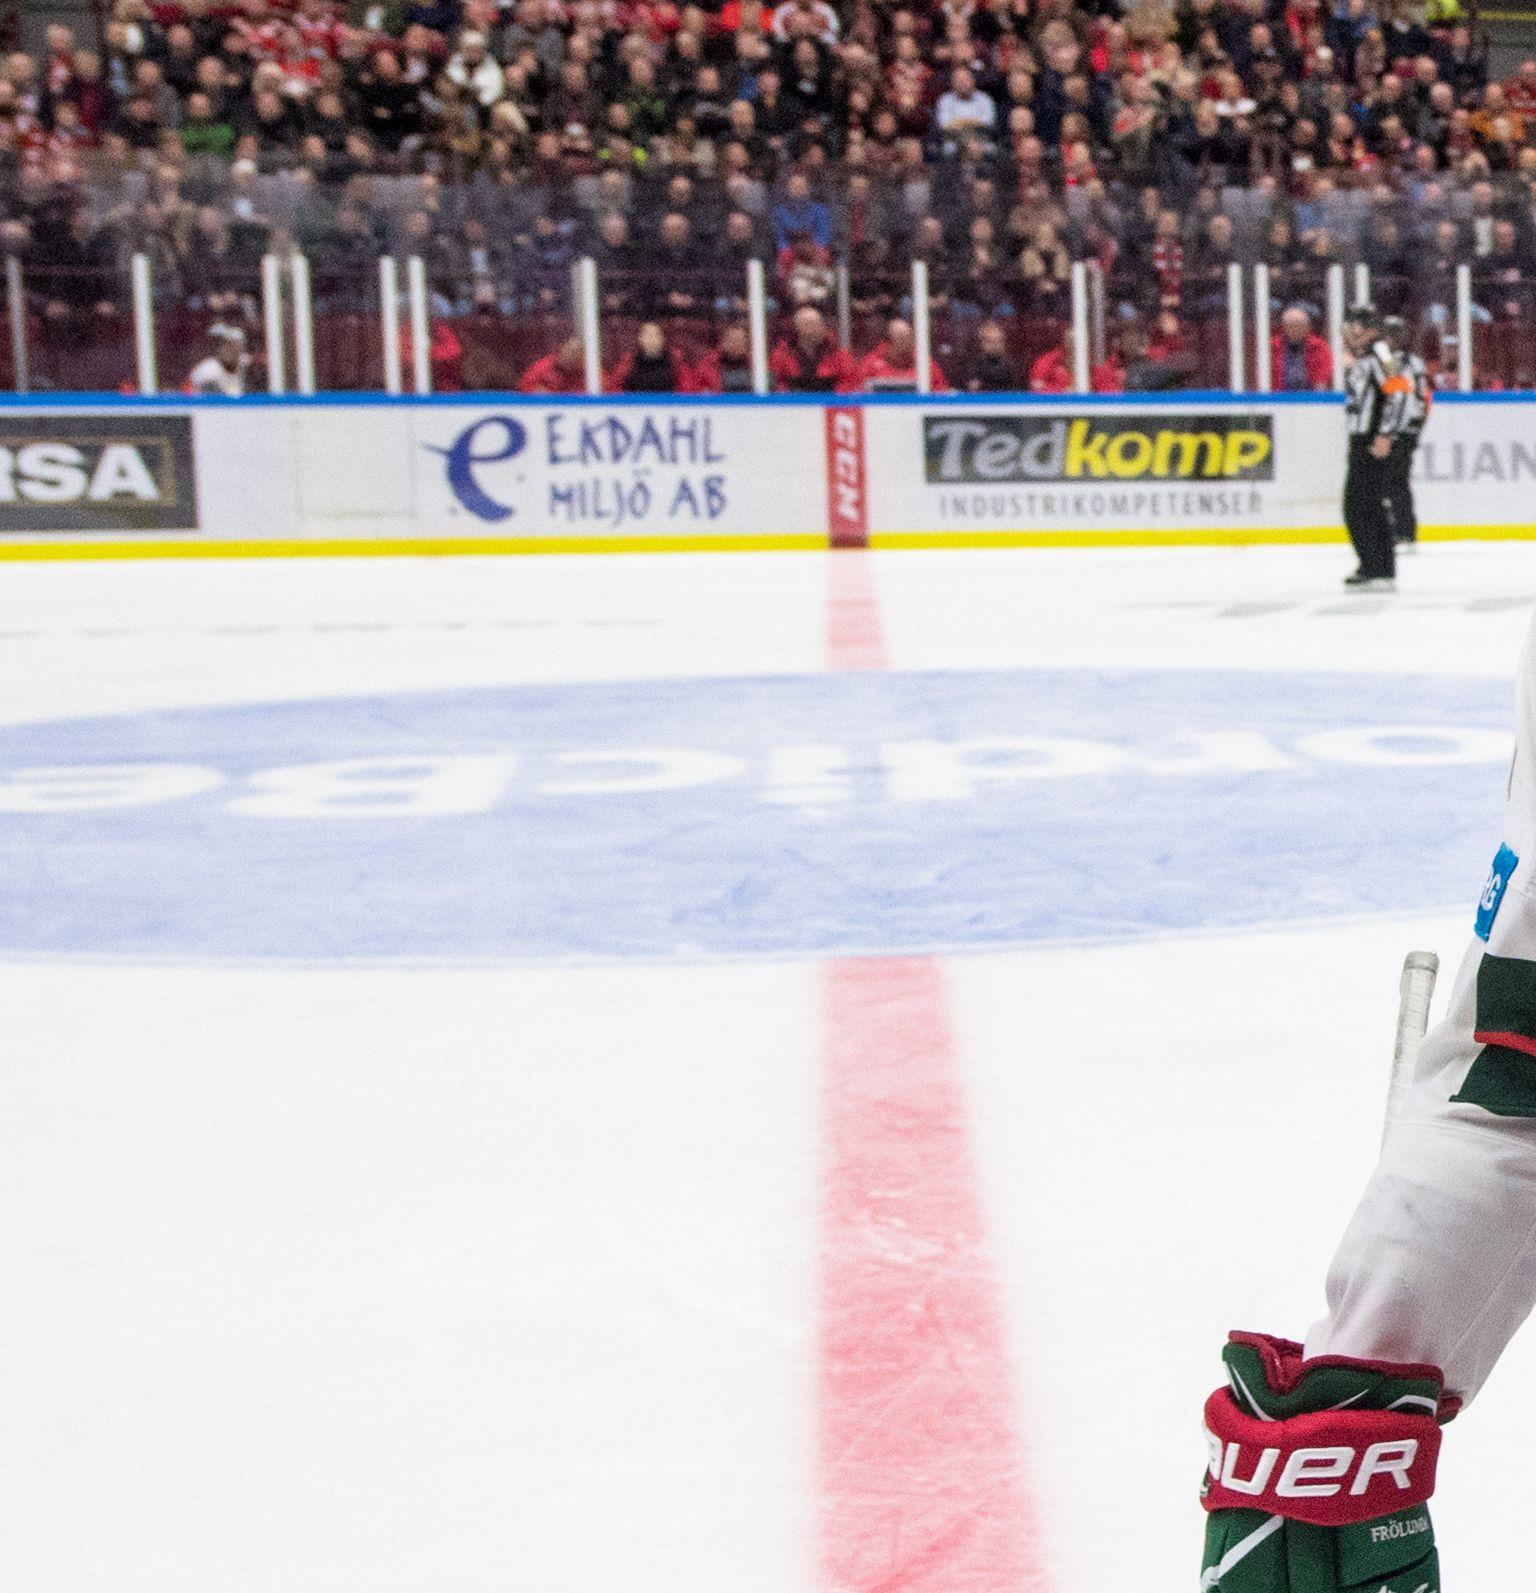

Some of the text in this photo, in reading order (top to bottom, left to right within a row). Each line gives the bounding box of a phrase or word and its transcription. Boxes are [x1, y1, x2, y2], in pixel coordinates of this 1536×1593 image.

[545, 414, 725, 465] EKDAHL
[927, 418, 1272, 478] Tedkomp
[669, 474, 727, 520] AB
[939, 489, 1264, 519] INDUSTRIKOMPETENSER
